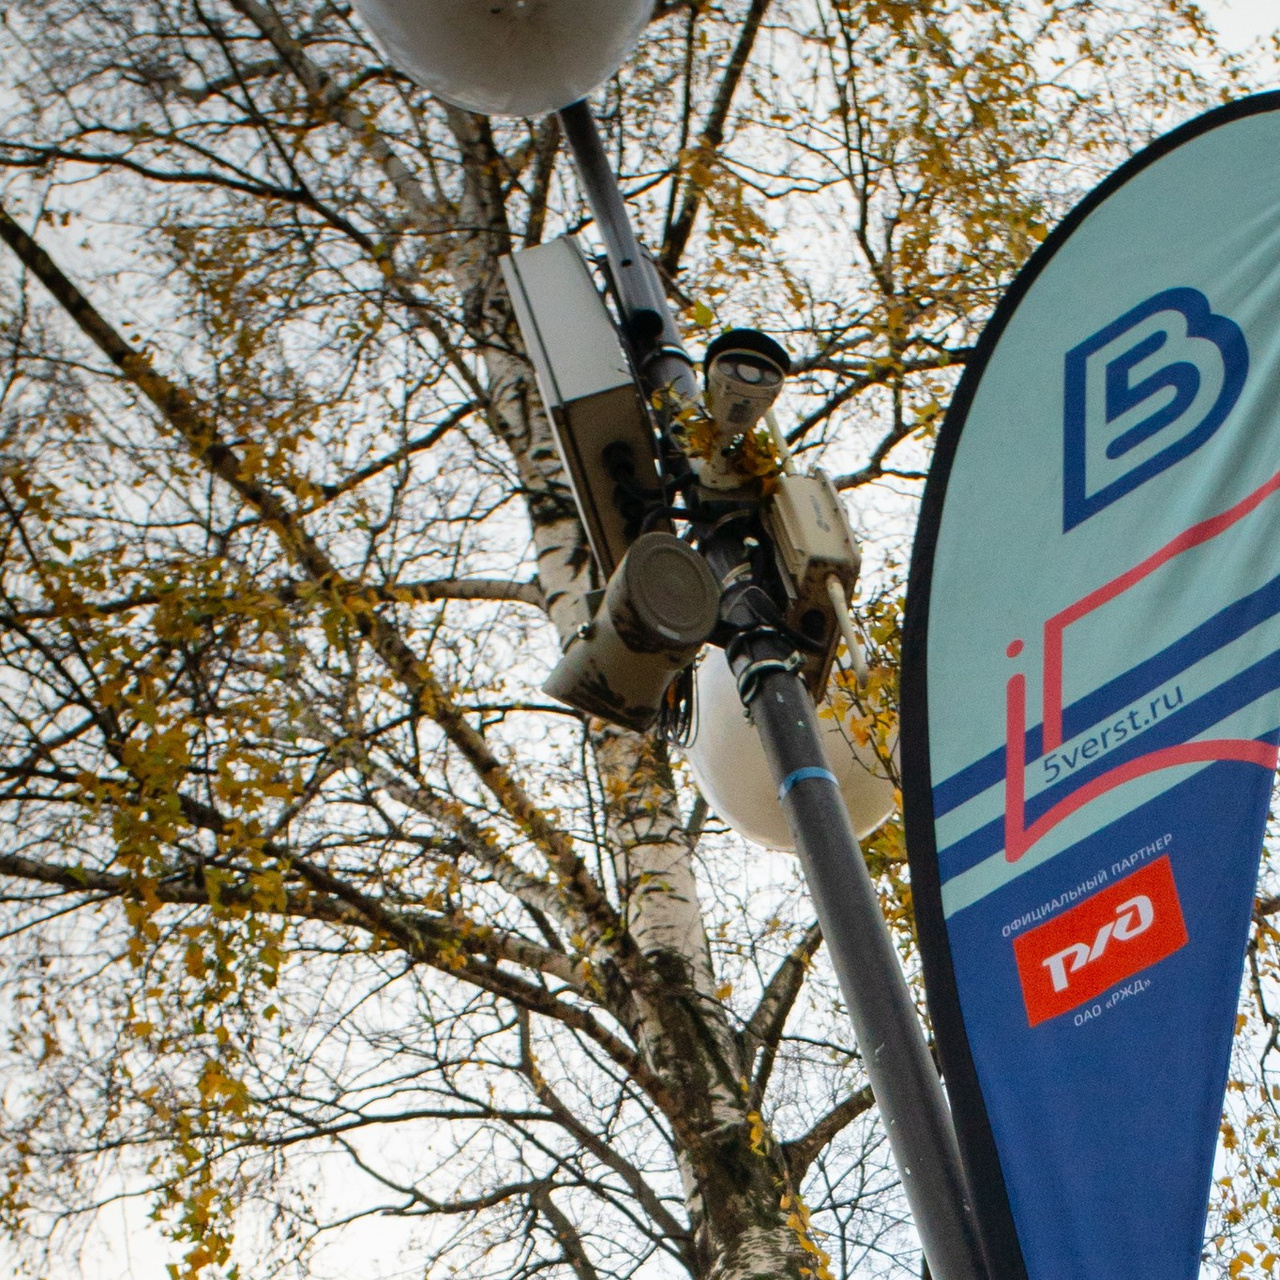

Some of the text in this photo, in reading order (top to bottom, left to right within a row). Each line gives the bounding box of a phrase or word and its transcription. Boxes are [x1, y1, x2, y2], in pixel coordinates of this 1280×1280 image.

[1044, 686, 1184, 784] 5verst.ru
[1002, 833, 1173, 937] ОФИЦИАЛЬНЫЙ ПАРТНЕР
[1074, 979, 1151, 1027] ОАО «РЖД»
